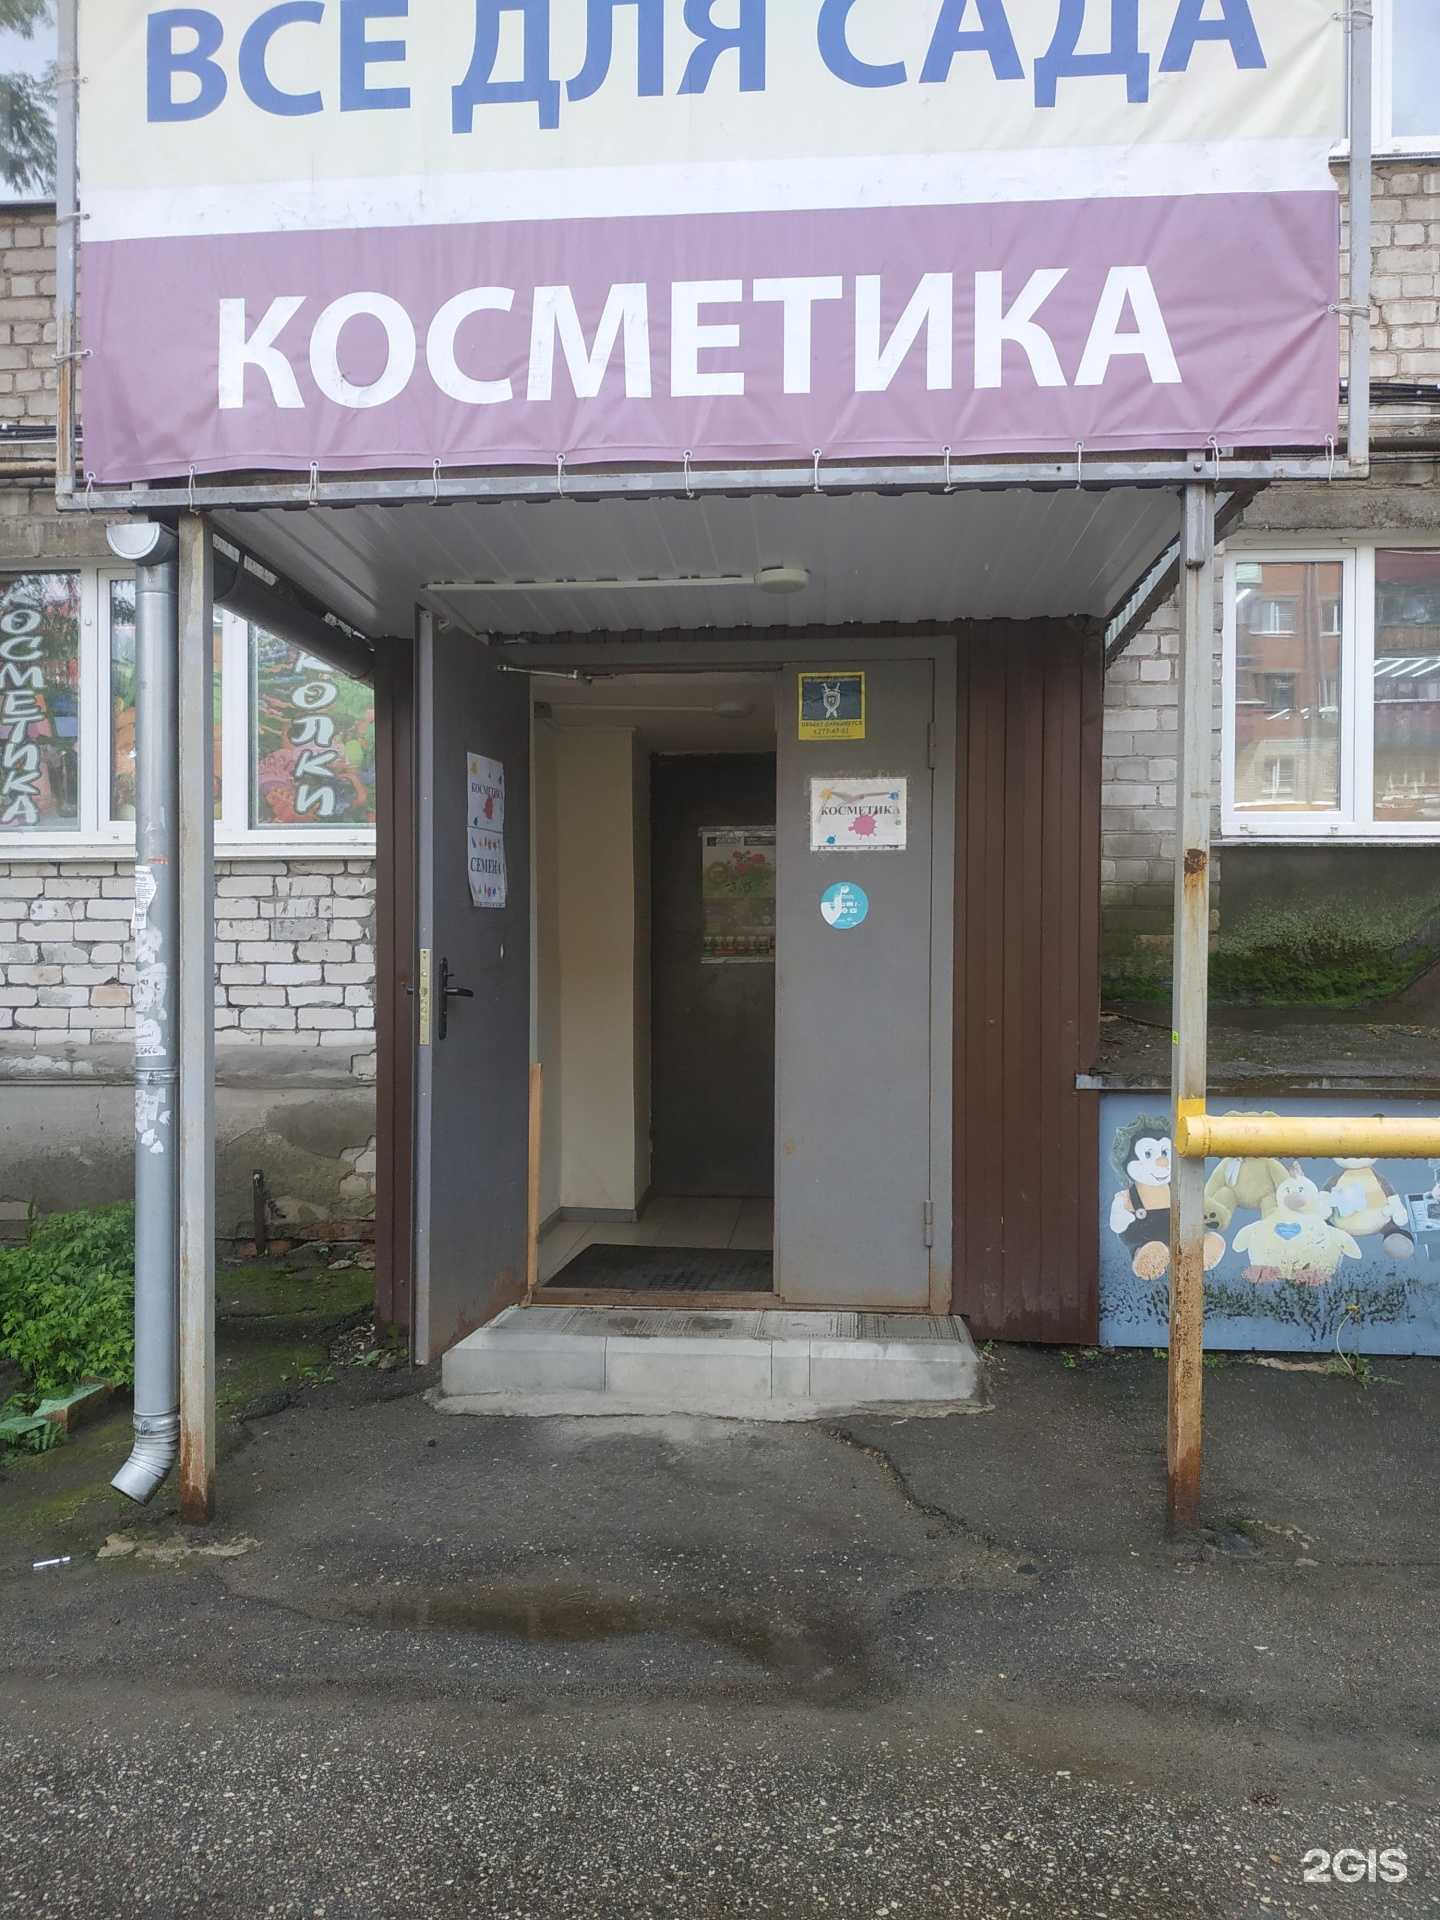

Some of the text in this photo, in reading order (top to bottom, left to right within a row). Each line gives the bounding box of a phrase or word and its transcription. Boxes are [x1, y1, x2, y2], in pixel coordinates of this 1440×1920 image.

[147, 0, 1265, 134] ВСЕ ДЛЯ САДА
[217, 265, 1183, 409] КОСМЕТИКА
[820, 804, 900, 816] КОСМЕТИКА
